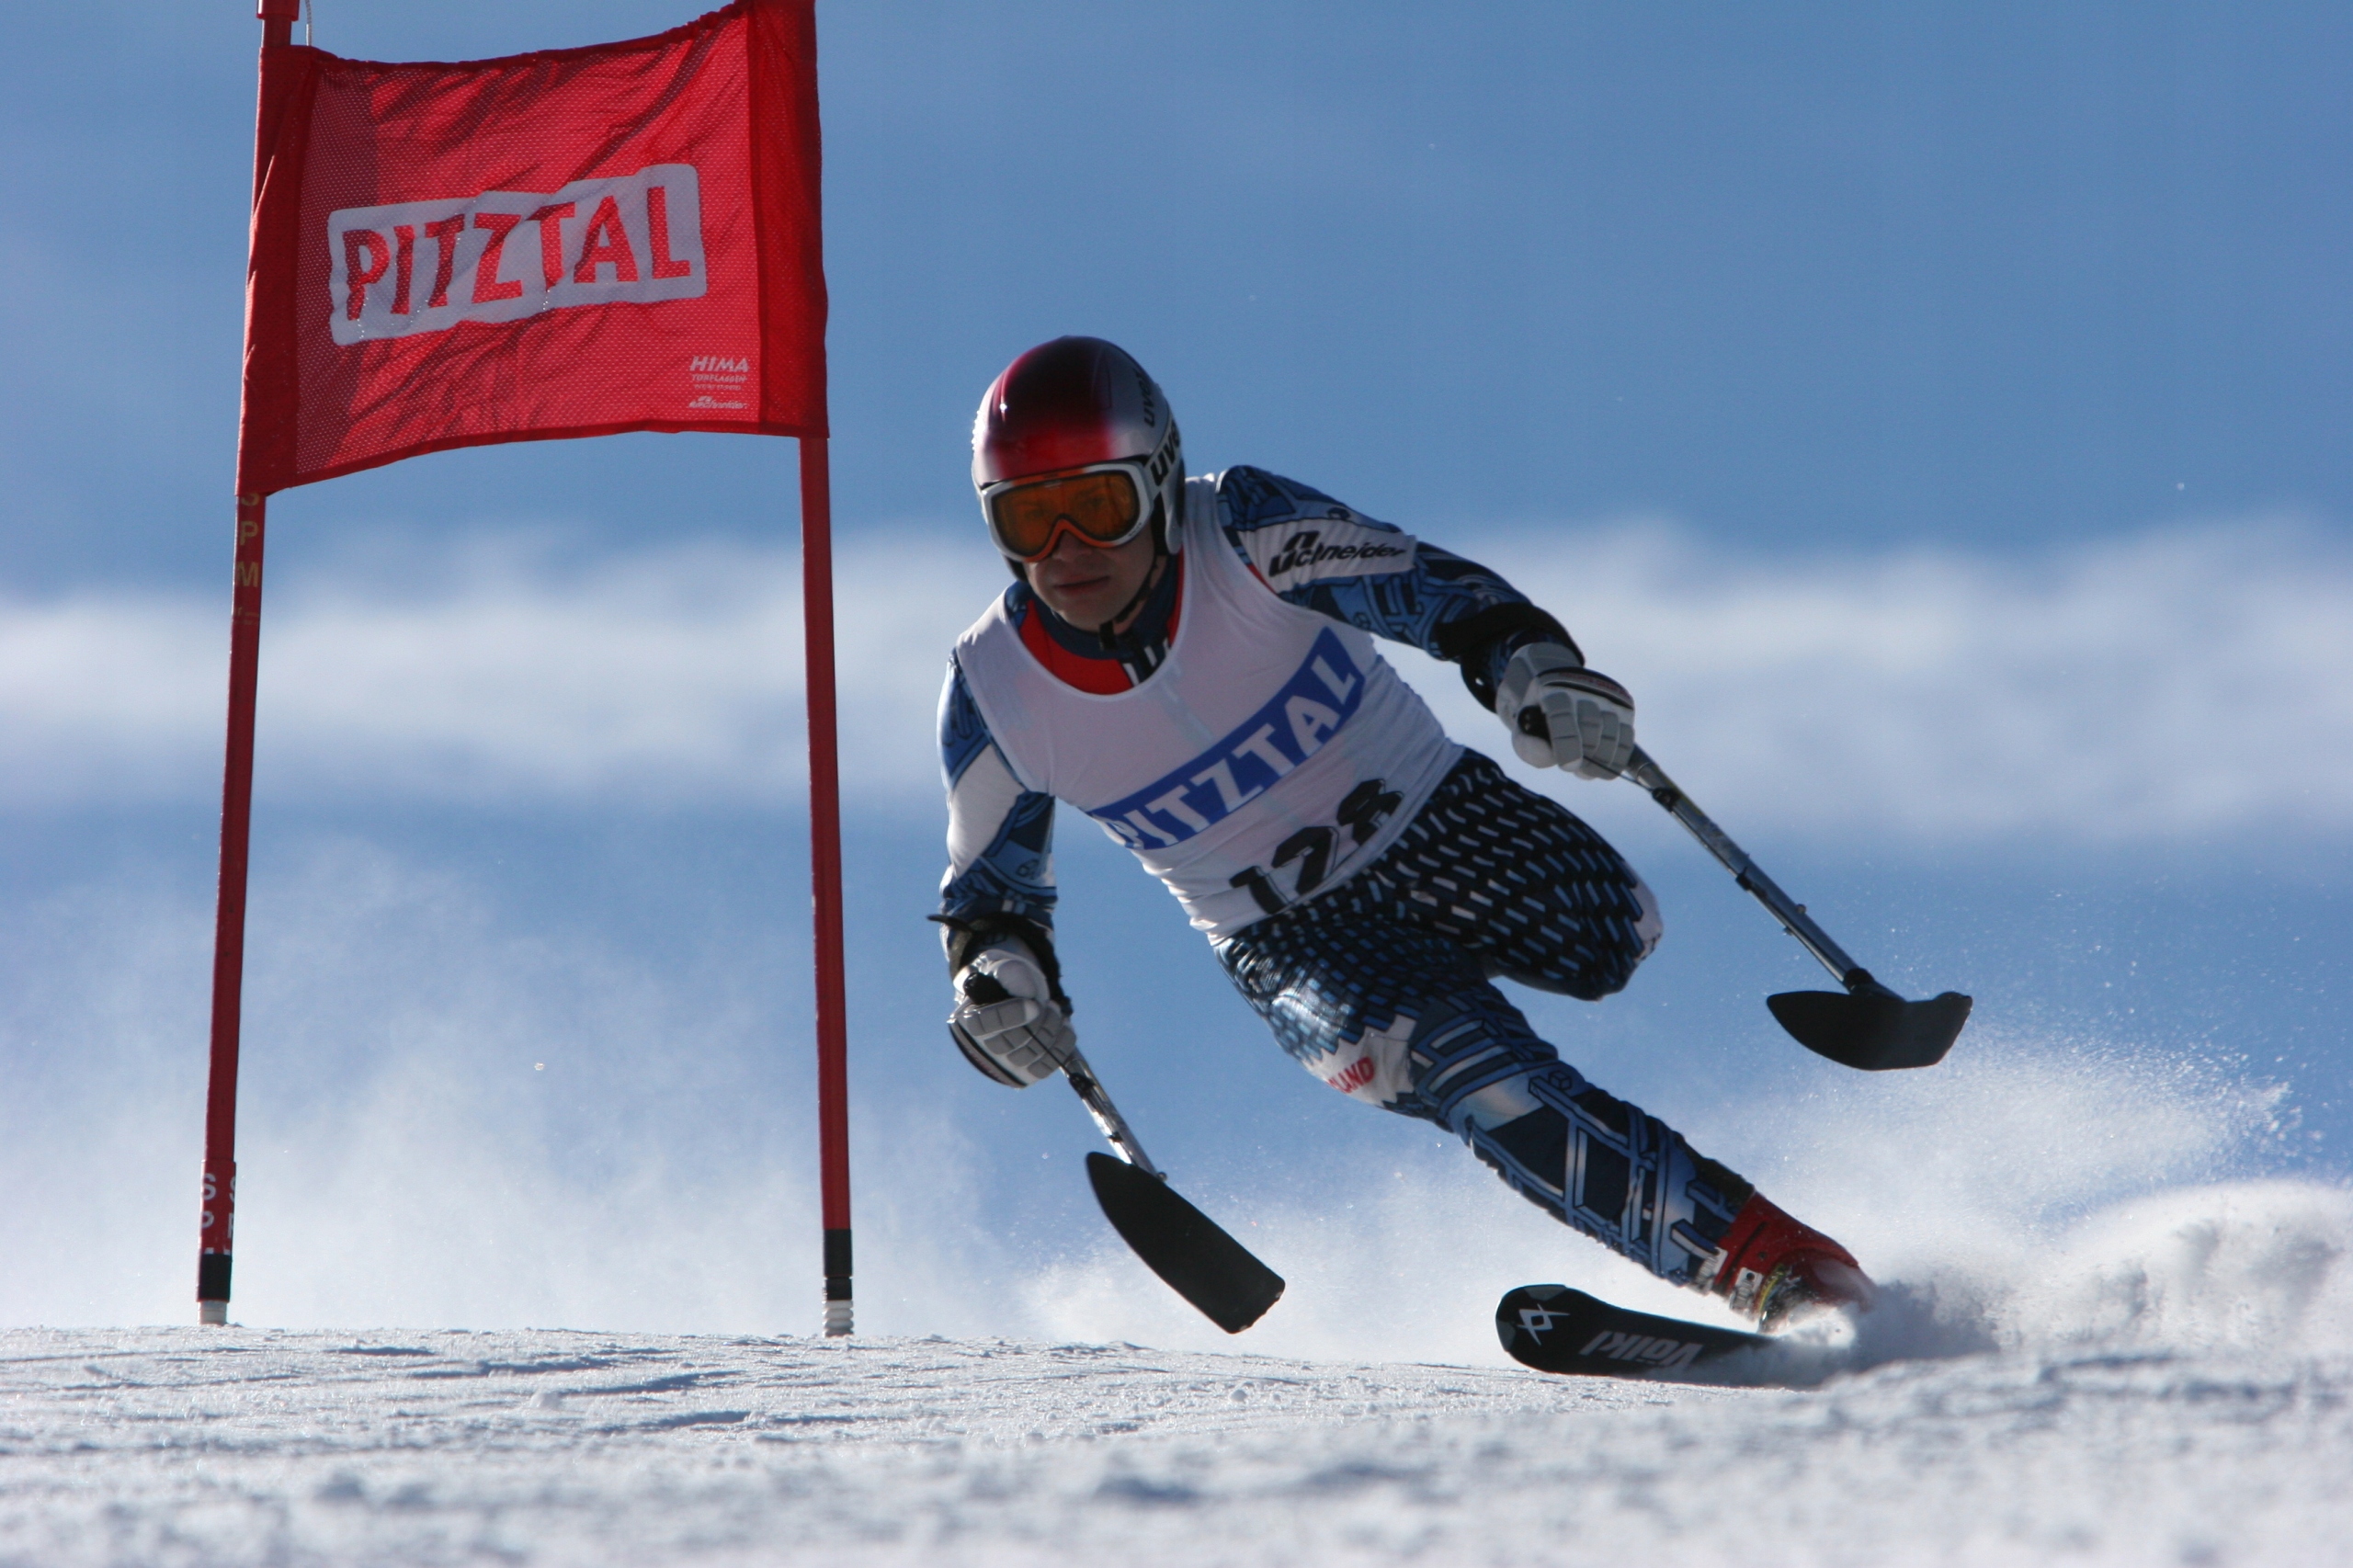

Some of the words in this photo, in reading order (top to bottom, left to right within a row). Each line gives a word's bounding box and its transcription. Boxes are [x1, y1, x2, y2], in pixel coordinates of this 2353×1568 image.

[342, 186, 691, 321] PITZTAL
[689, 355, 749, 372] HIMA
[1092, 654, 1357, 849] PITZTAL
